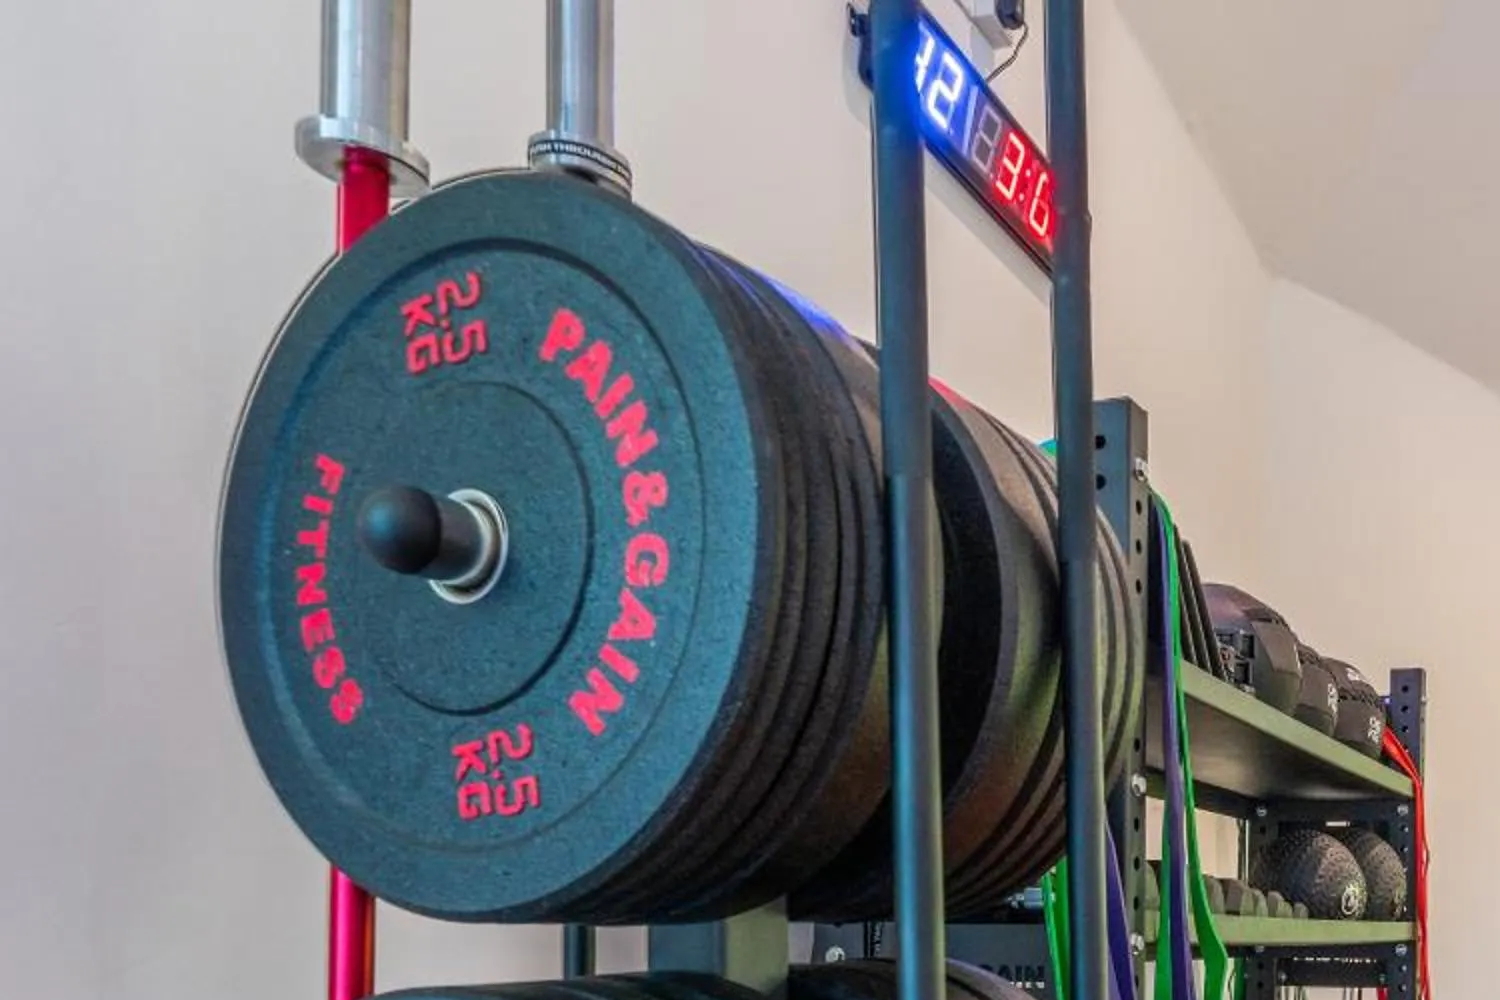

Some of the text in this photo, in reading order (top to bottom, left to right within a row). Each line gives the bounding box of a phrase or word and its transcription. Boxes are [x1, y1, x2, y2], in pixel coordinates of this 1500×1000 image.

[401, 293, 442, 374] KG
[436, 271, 487, 363] 2.5
[539, 308, 669, 735] PAIN&GAIN
[295, 454, 364, 724] FITNESS
[452, 739, 492, 820] KG
[486, 724, 540, 817] 2.5
